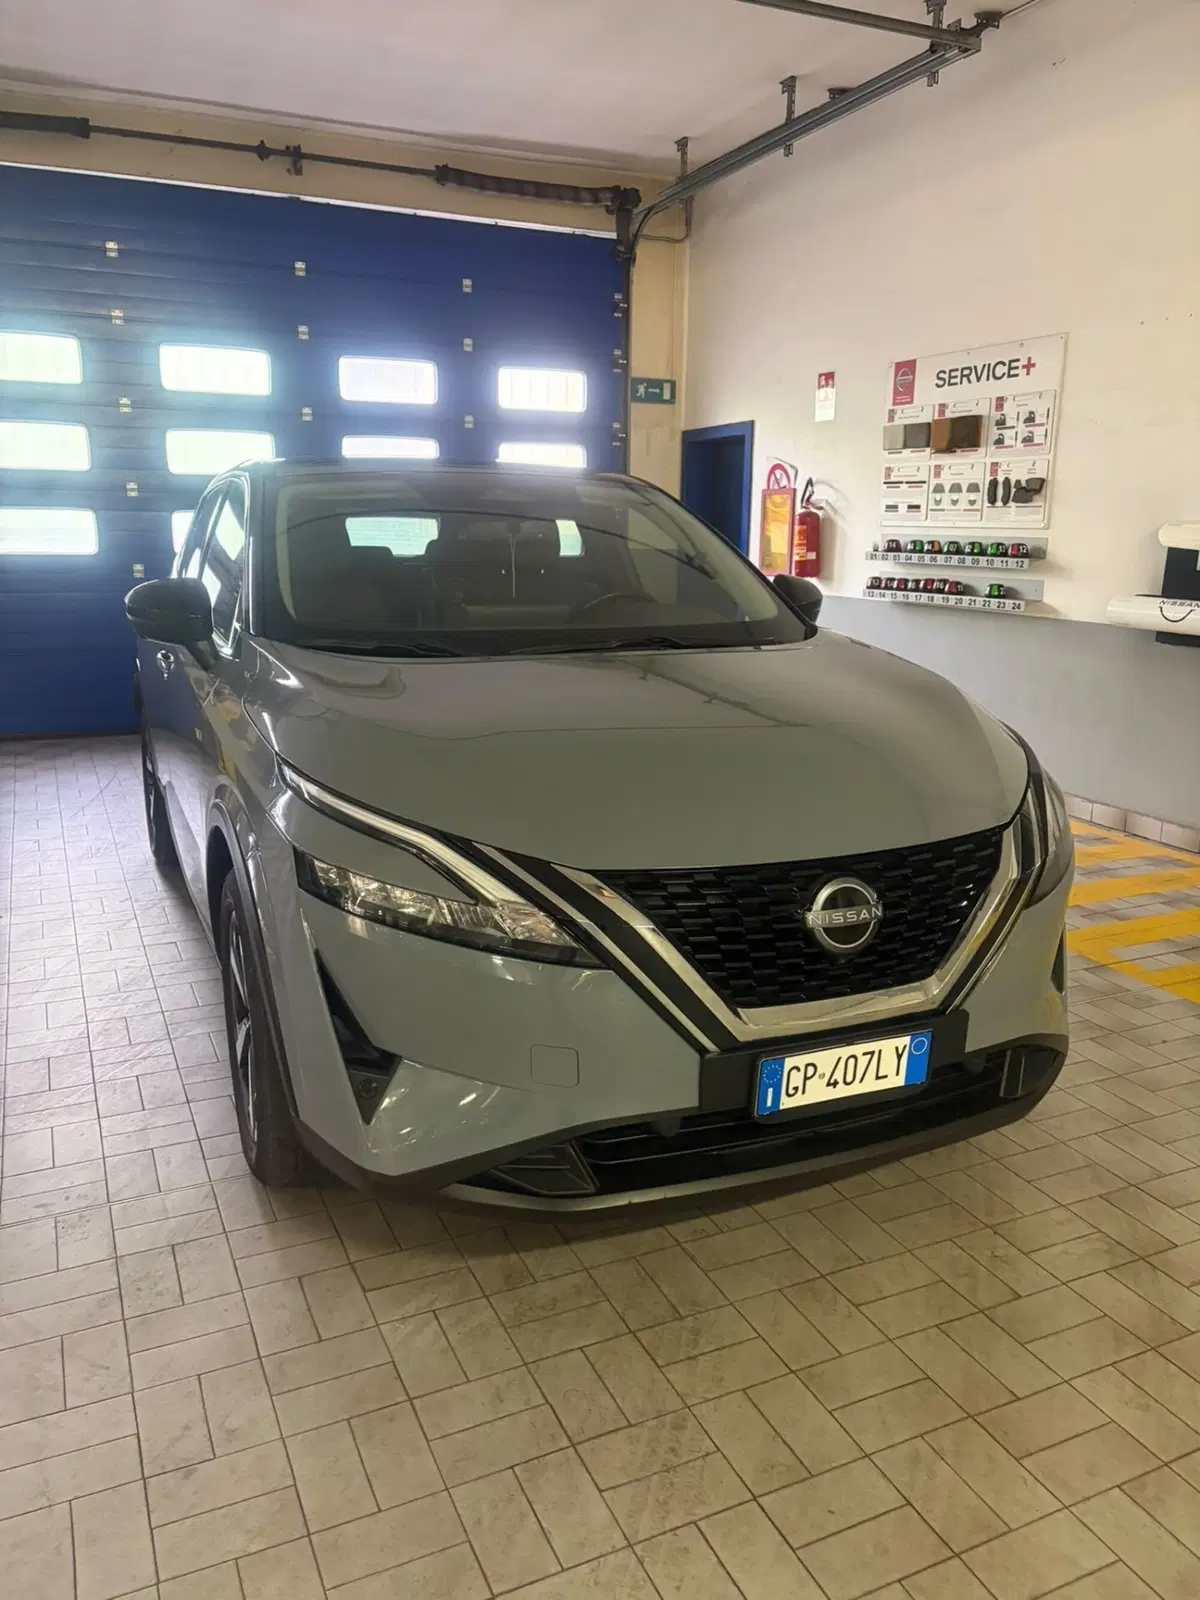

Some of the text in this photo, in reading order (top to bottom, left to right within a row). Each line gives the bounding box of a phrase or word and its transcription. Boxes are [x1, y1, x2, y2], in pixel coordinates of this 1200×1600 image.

[1019, 545, 1027, 553] 12
[944, 556, 952, 564] 07
[957, 557, 966, 565] 08
[971, 558, 980, 566] 09
[1000, 559, 1008, 567] 11
[1015, 560, 1024, 568] 12
[927, 595, 934, 603] 18
[942, 596, 949, 604] 19
[955, 597, 963, 605] 20
[968, 598, 976, 606] 21
[1012, 602, 1020, 610] 24
[808, 905, 882, 925] NISSAN
